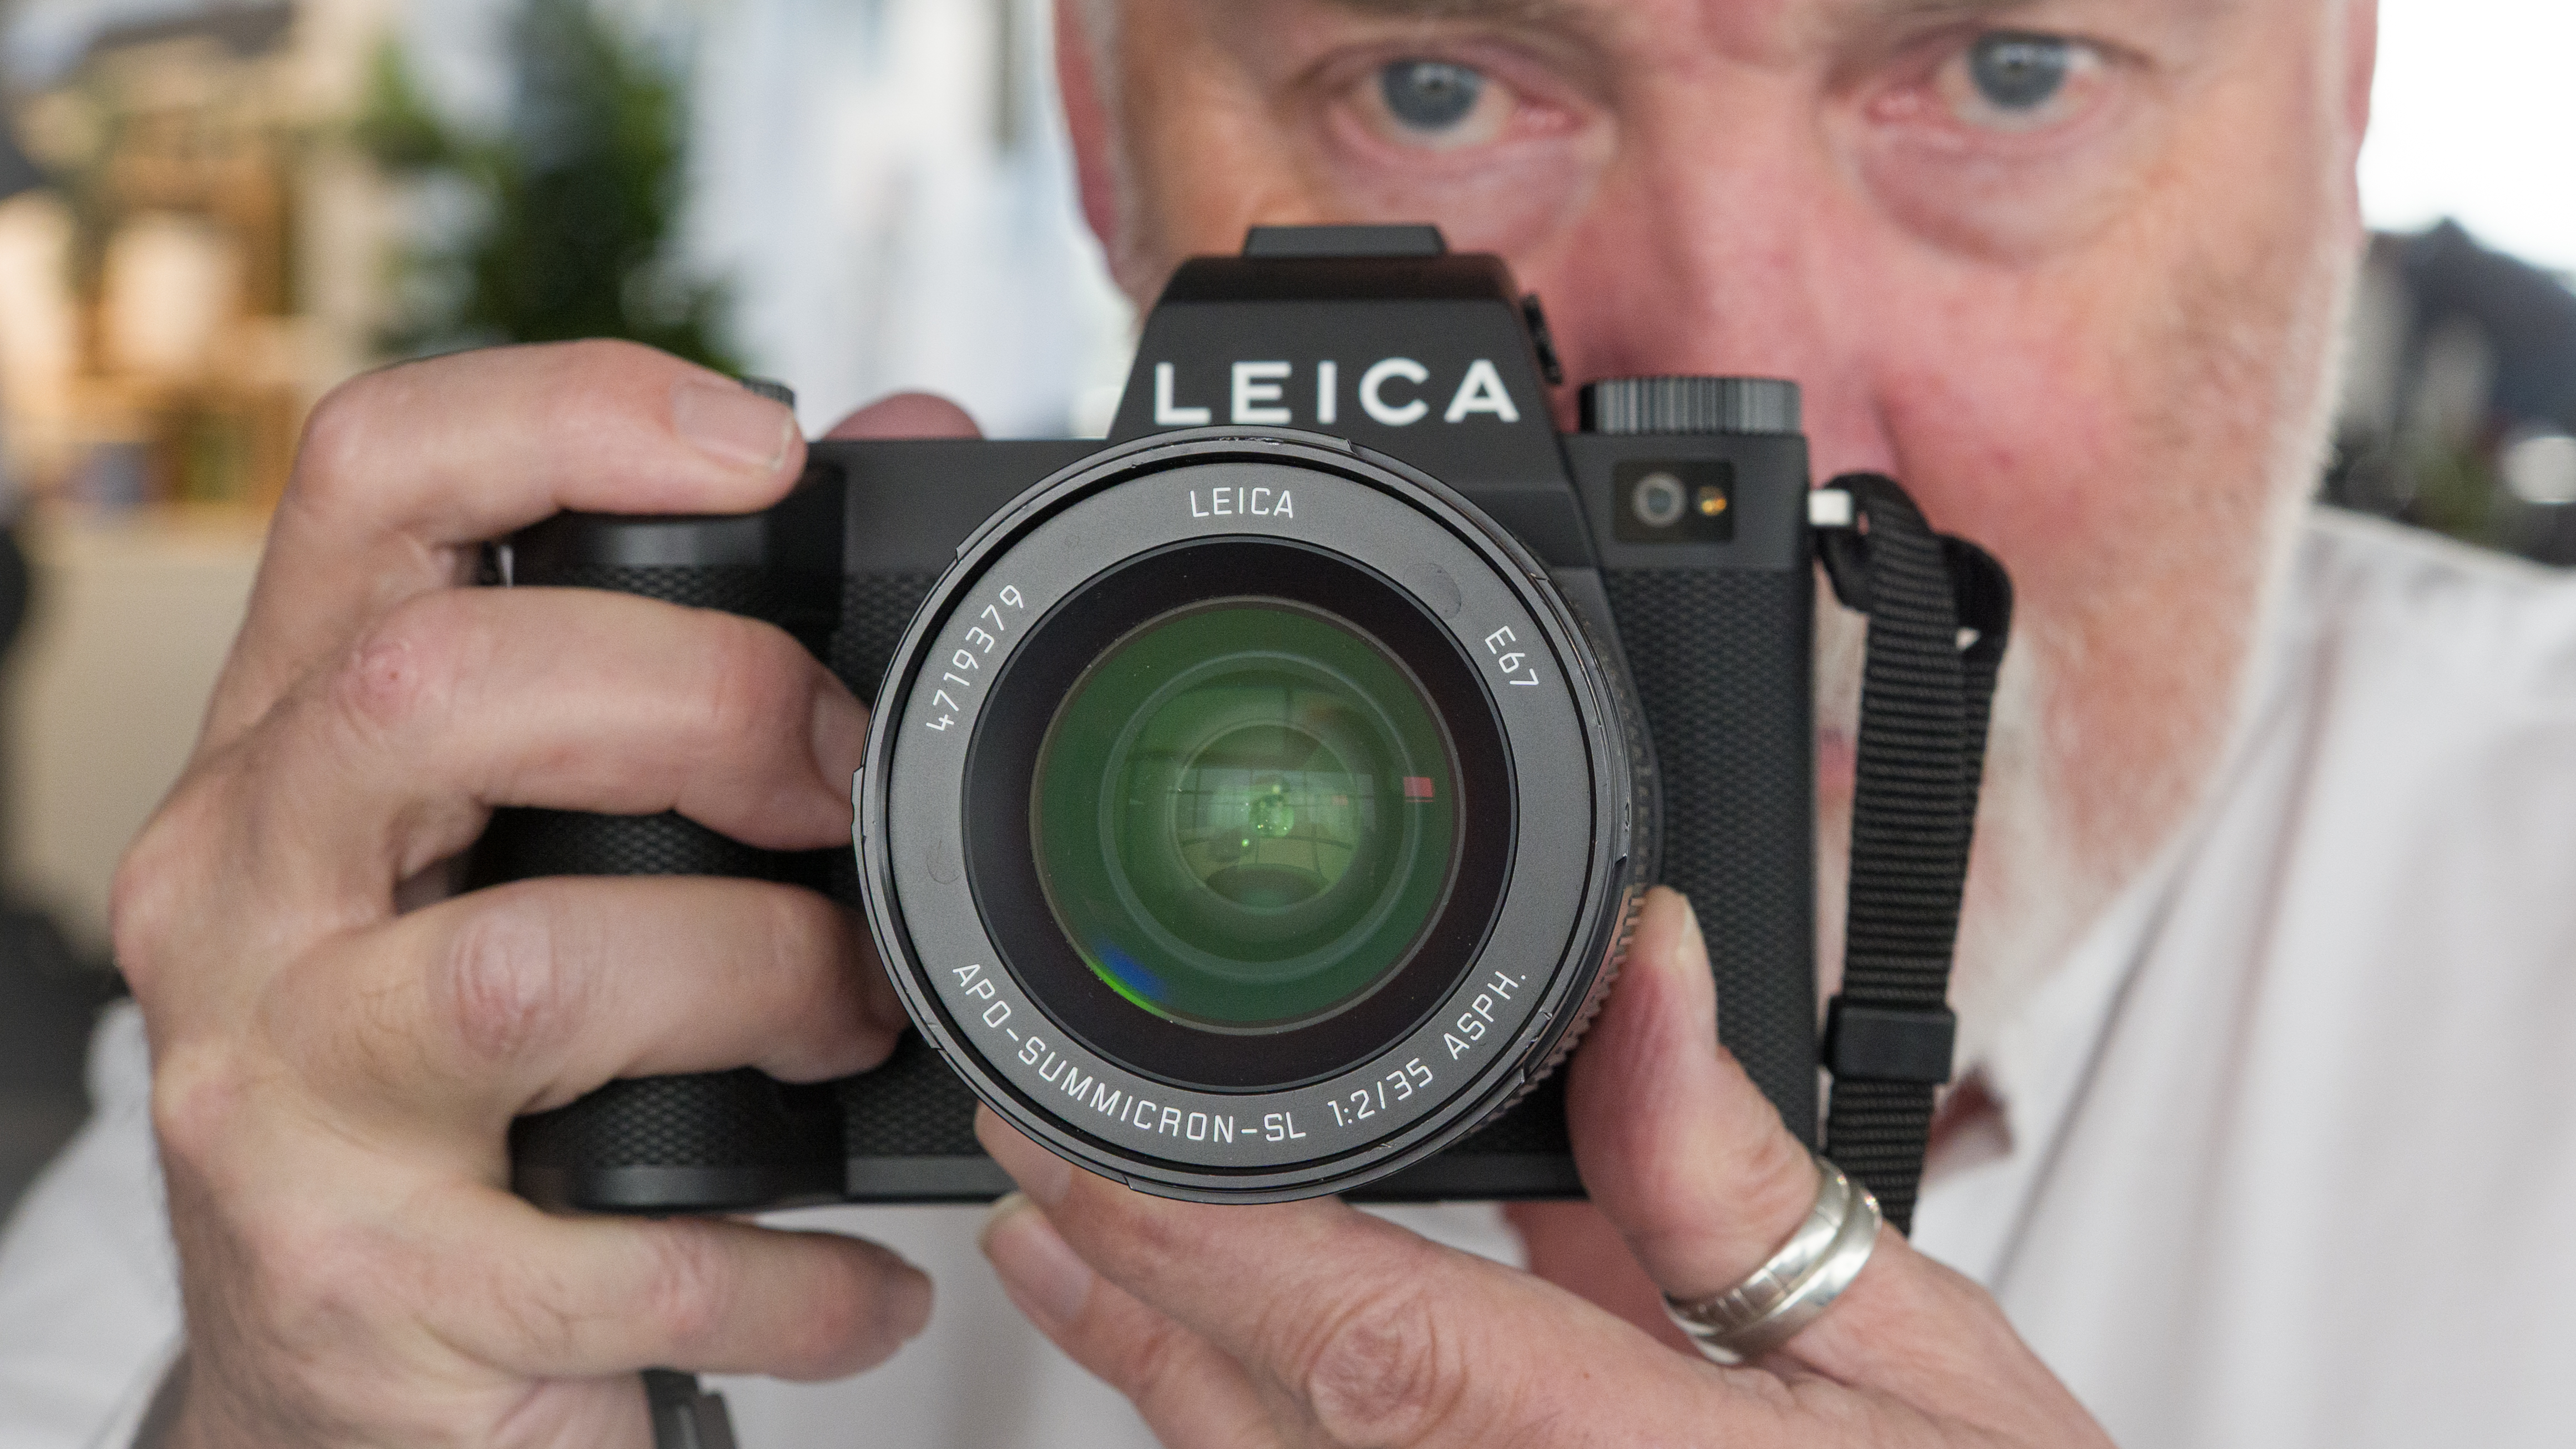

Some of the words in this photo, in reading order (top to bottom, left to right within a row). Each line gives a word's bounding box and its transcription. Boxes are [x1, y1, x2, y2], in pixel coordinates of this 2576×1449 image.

[1155, 358, 1519, 425] LEICA
[1190, 487, 1294, 520] LEICA
[925, 584, 1024, 732] 4719379
[1484, 625, 1540, 686] E67
[952, 964, 1307, 1143] APO-SUMMICRON-SL
[1327, 1057, 1433, 1127] 1:2/35
[1443, 971, 1526, 1060] ASPH.
